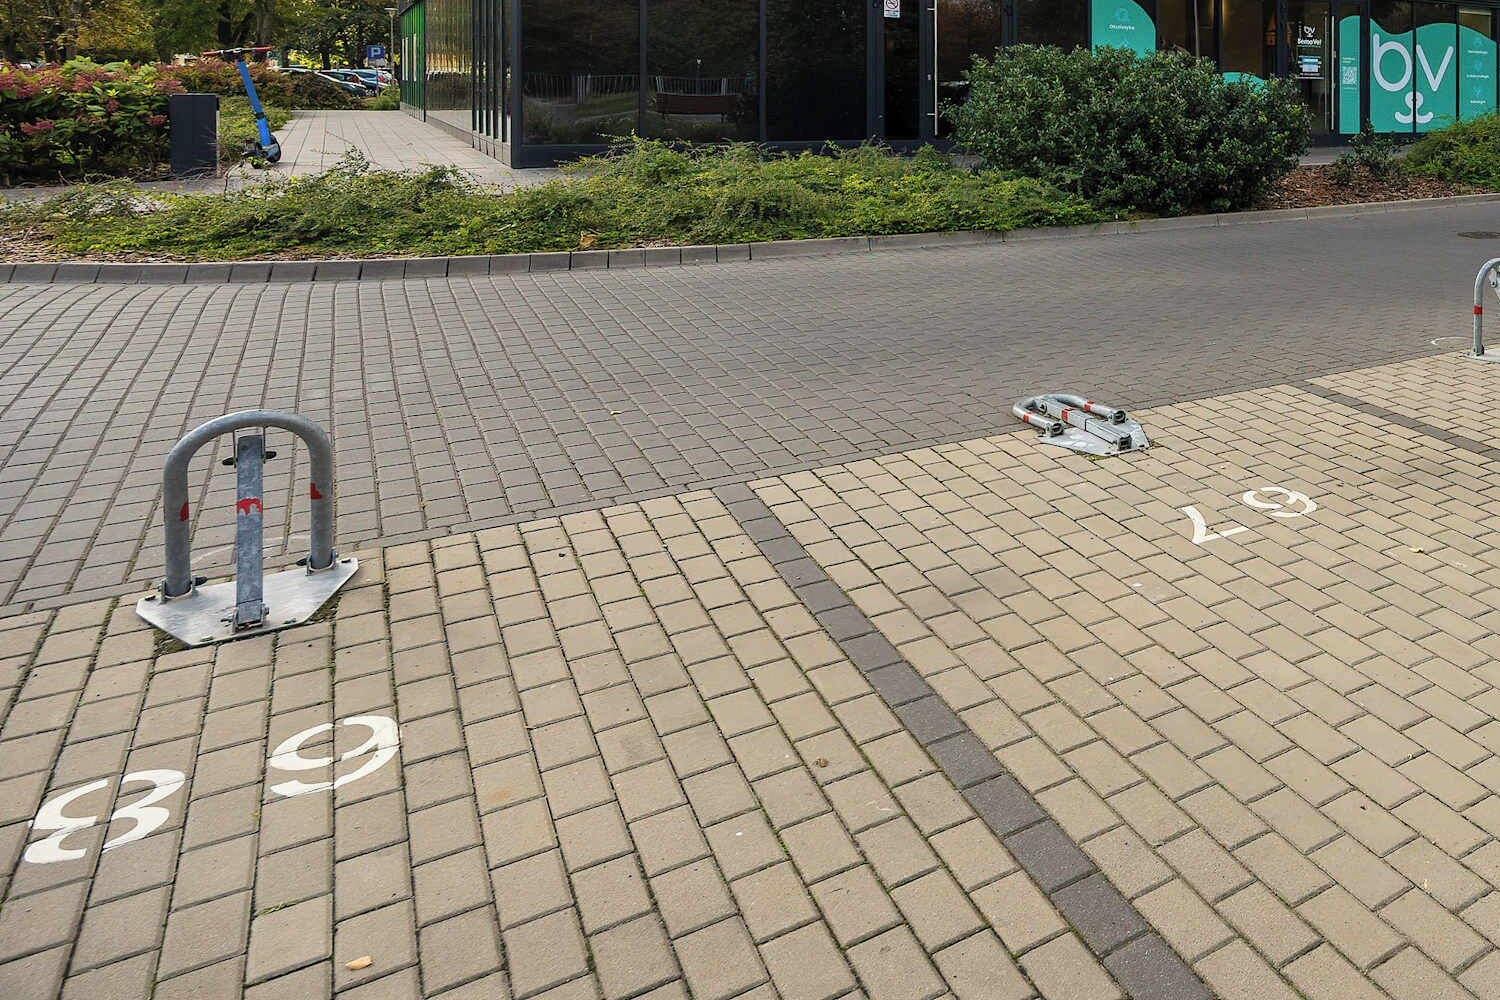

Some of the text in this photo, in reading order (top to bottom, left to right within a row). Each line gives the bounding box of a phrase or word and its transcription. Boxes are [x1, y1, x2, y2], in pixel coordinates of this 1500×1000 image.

[370, 47, 382, 58] P
[1181, 486, 1318, 545] 67
[23, 715, 400, 864] 68
